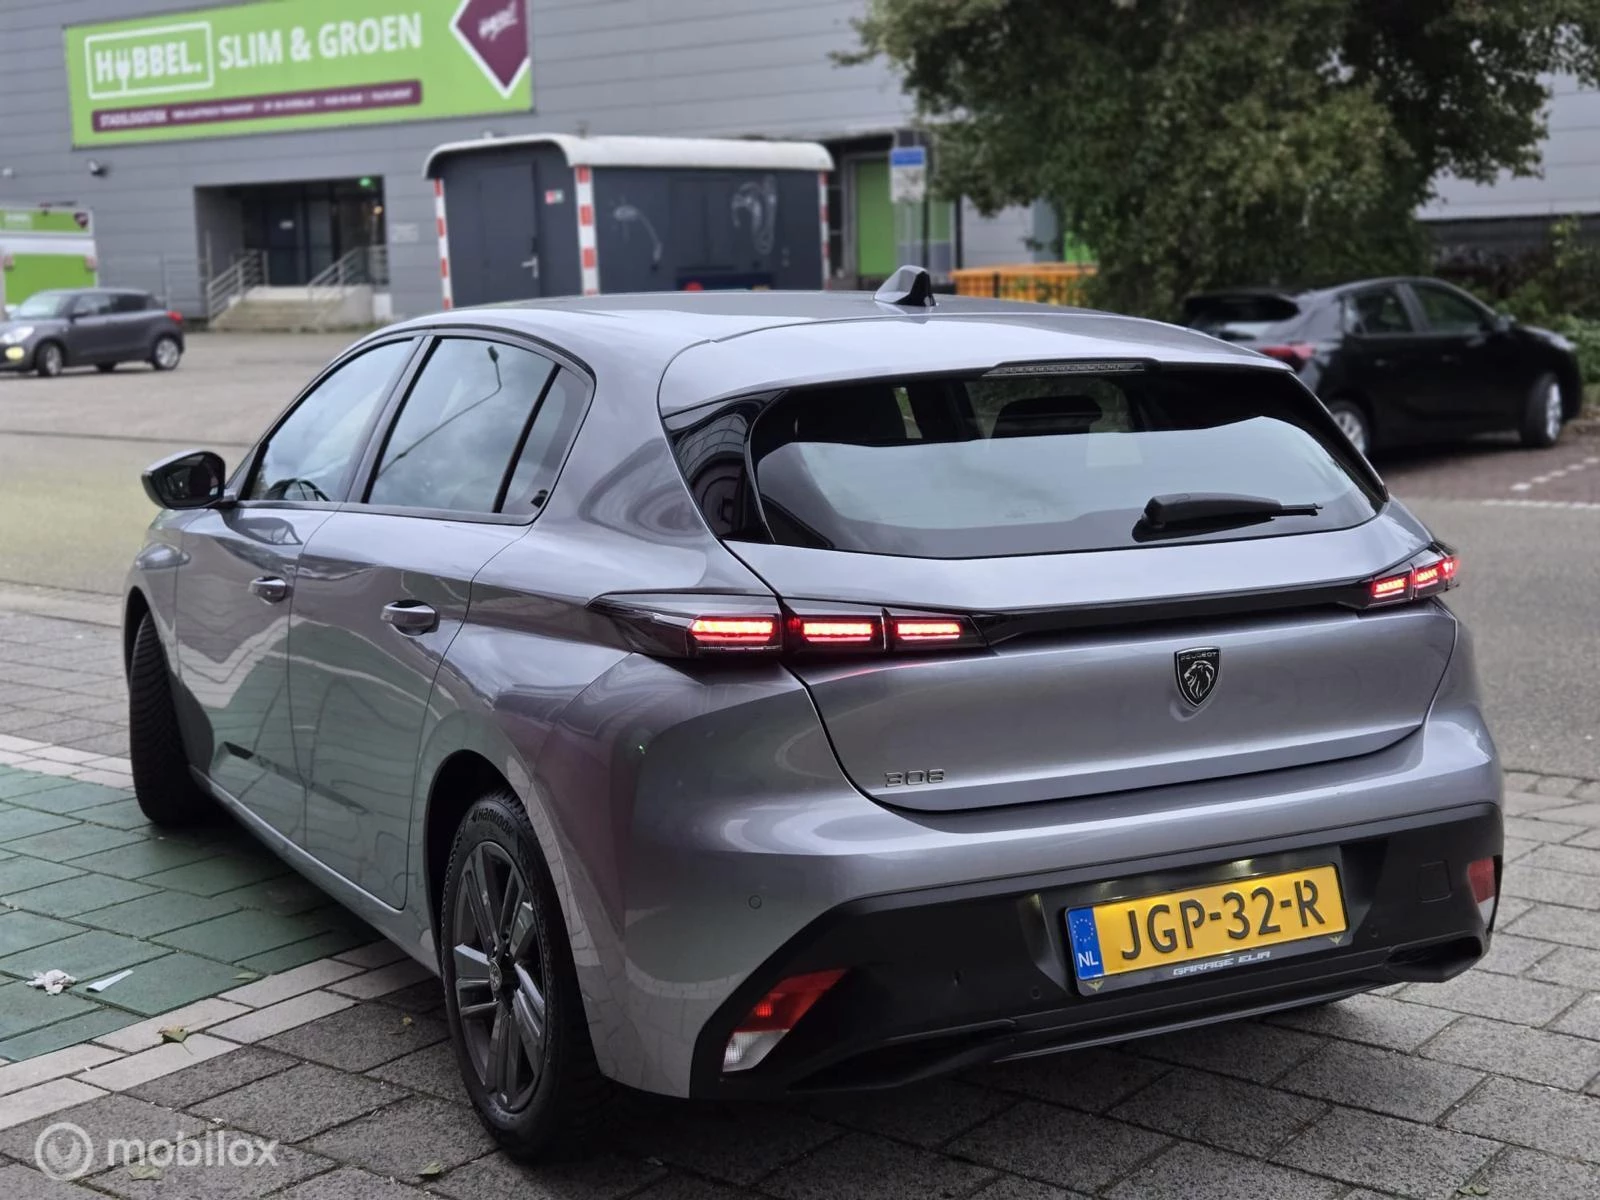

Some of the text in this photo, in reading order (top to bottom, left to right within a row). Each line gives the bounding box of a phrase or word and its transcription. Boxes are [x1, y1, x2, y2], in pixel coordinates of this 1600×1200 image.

[218, 12, 421, 70] SLIM & GROEN
[885, 769, 944, 787] 308
[1121, 879, 1326, 960] JGP-32-R
[1078, 951, 1099, 968] NL
[1173, 951, 1271, 976] GARAGE ELIA
